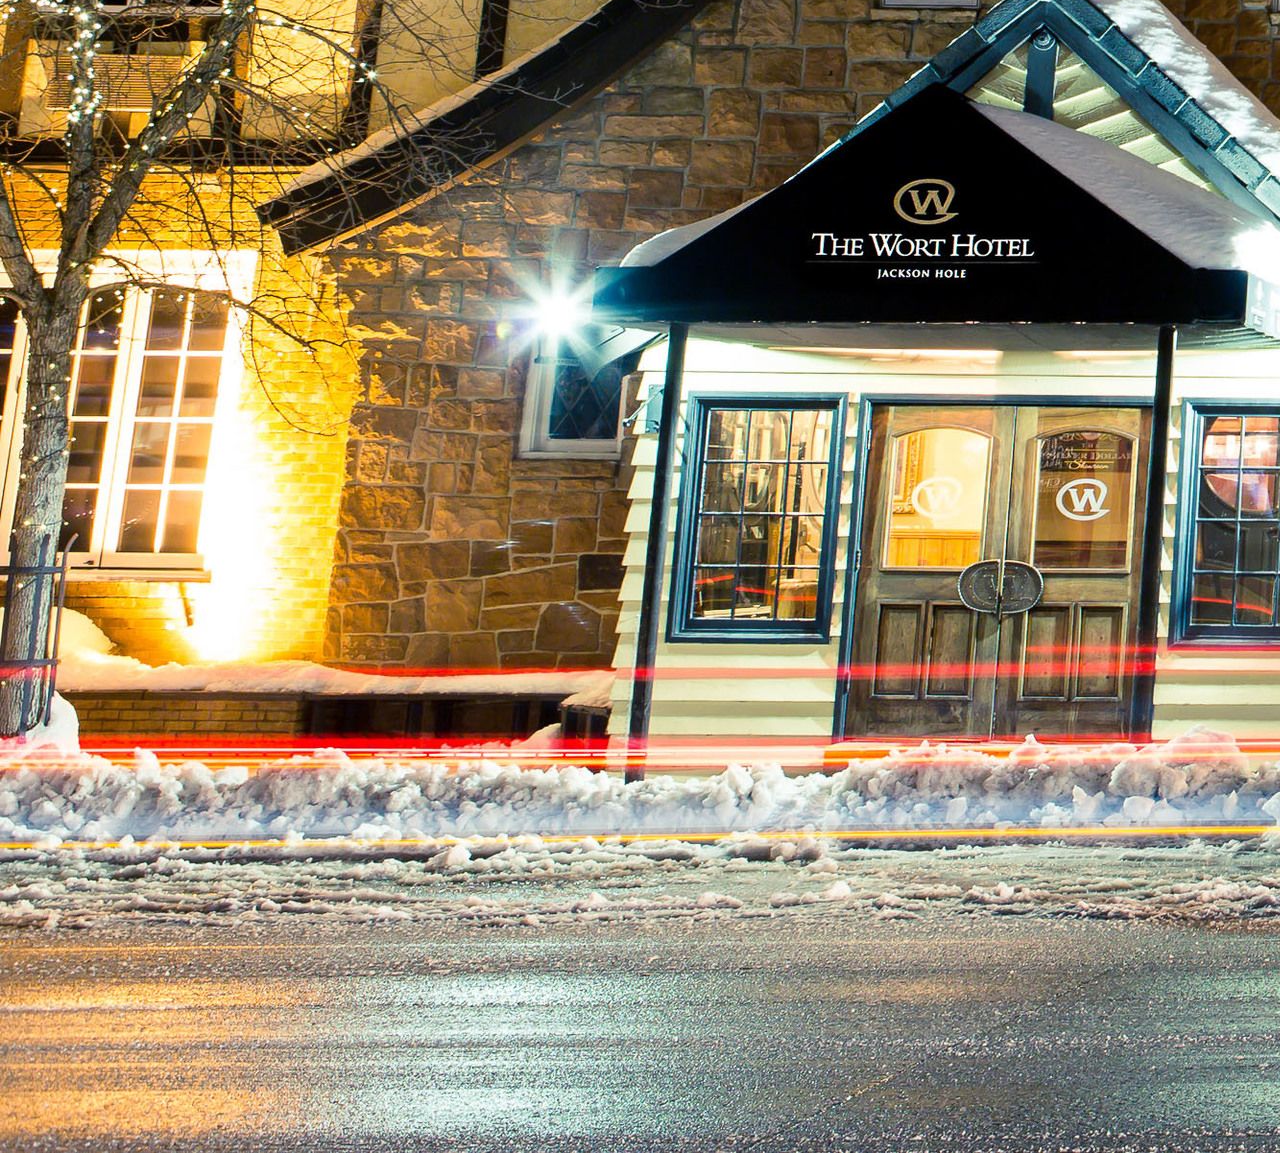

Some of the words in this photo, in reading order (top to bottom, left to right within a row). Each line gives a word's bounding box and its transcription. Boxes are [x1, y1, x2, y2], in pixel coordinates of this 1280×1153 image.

[811, 232, 864, 256] THE
[868, 233, 946, 257] WORT
[950, 234, 1035, 257] HOTEL
[877, 268, 930, 279] JACKSON
[935, 269, 967, 278] HOLE
